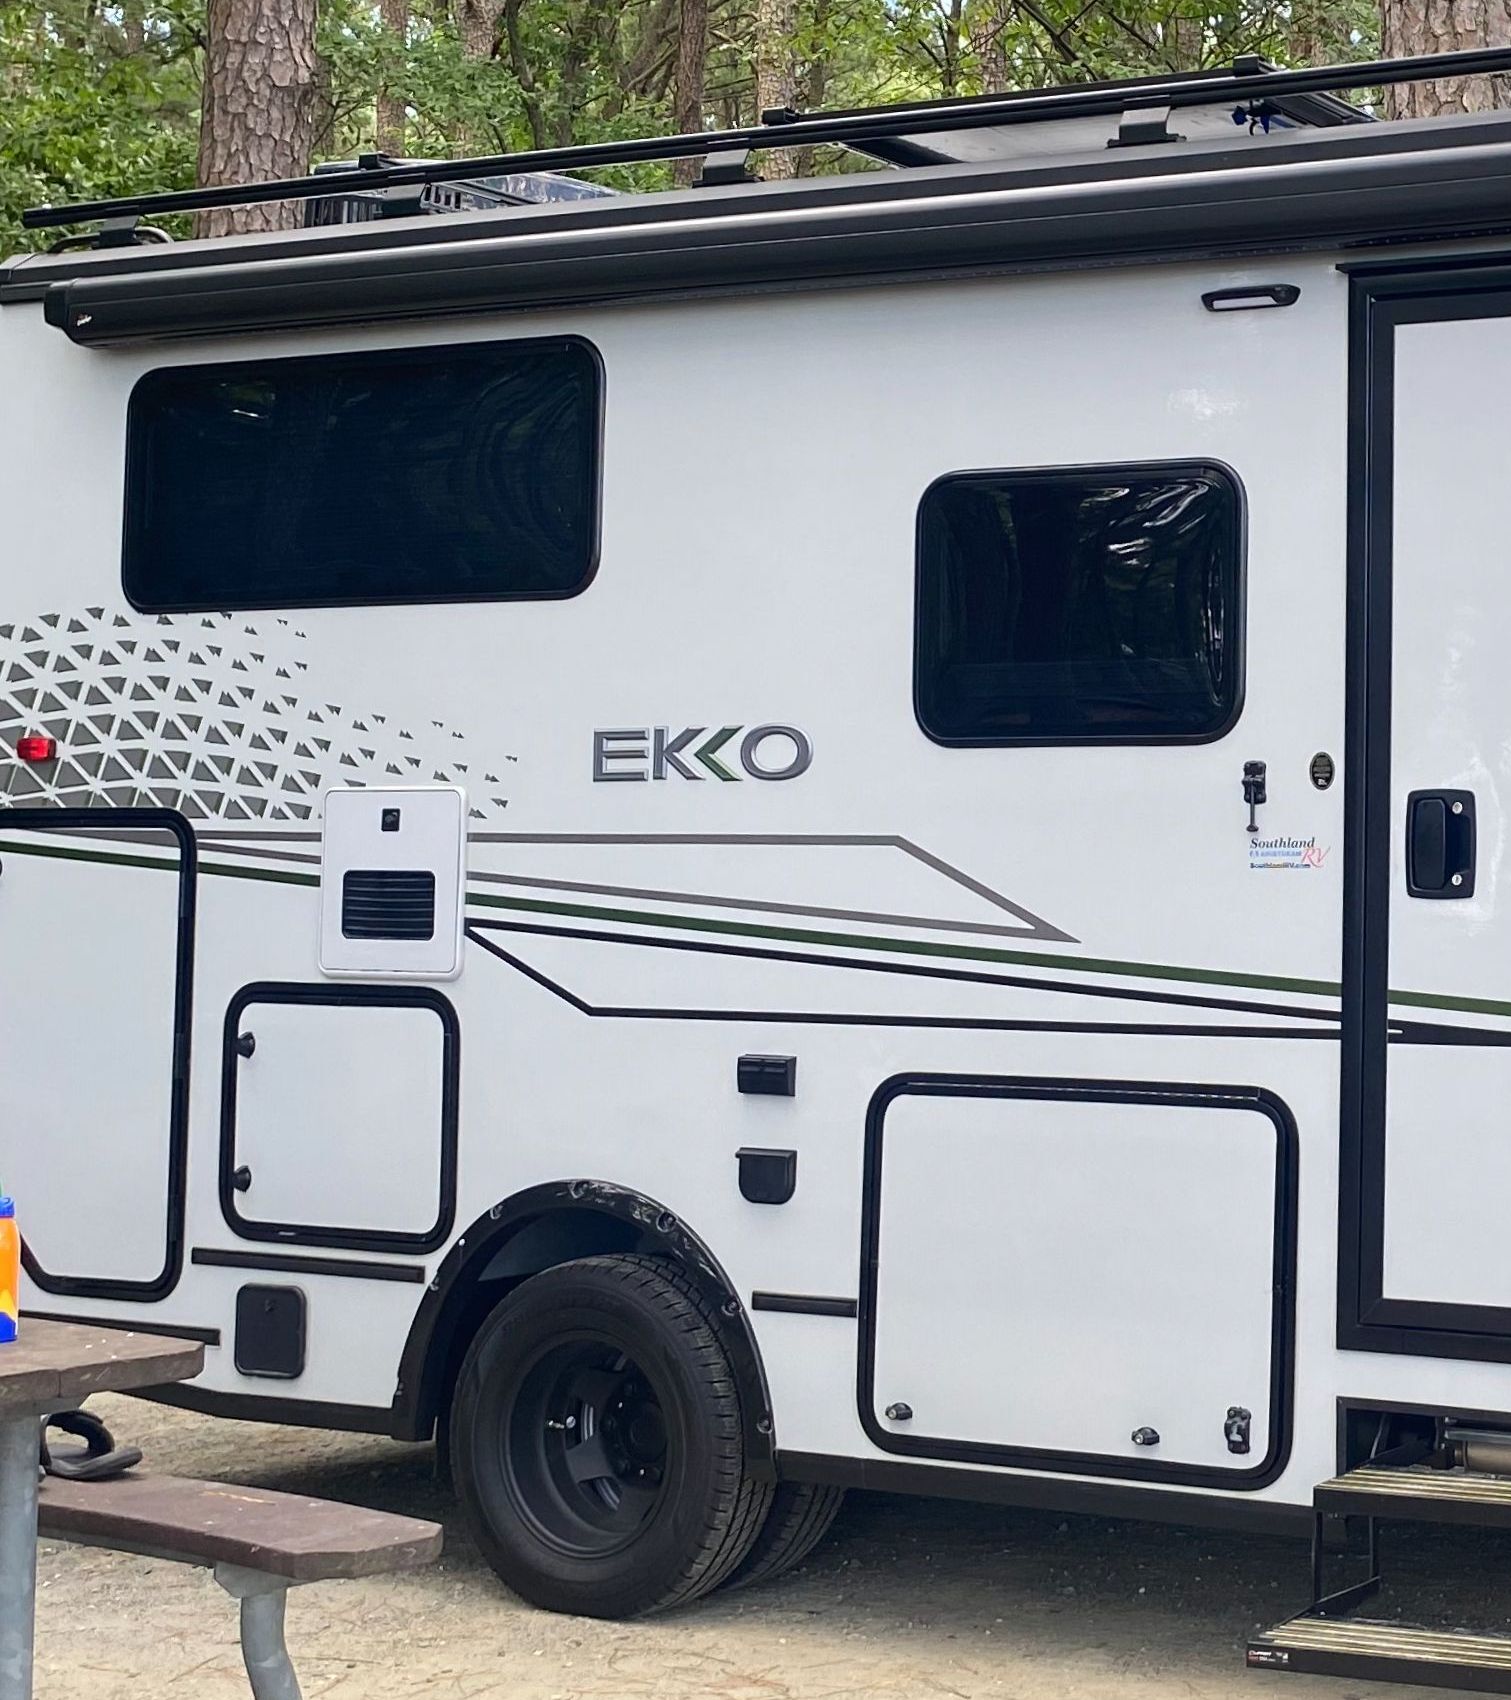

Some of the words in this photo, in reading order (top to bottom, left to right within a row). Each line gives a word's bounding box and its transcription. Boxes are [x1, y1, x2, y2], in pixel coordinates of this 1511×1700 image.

[592, 723, 814, 783] EKKO
[1250, 837, 1315, 849] Southland
[1301, 846, 1331, 868] RV
